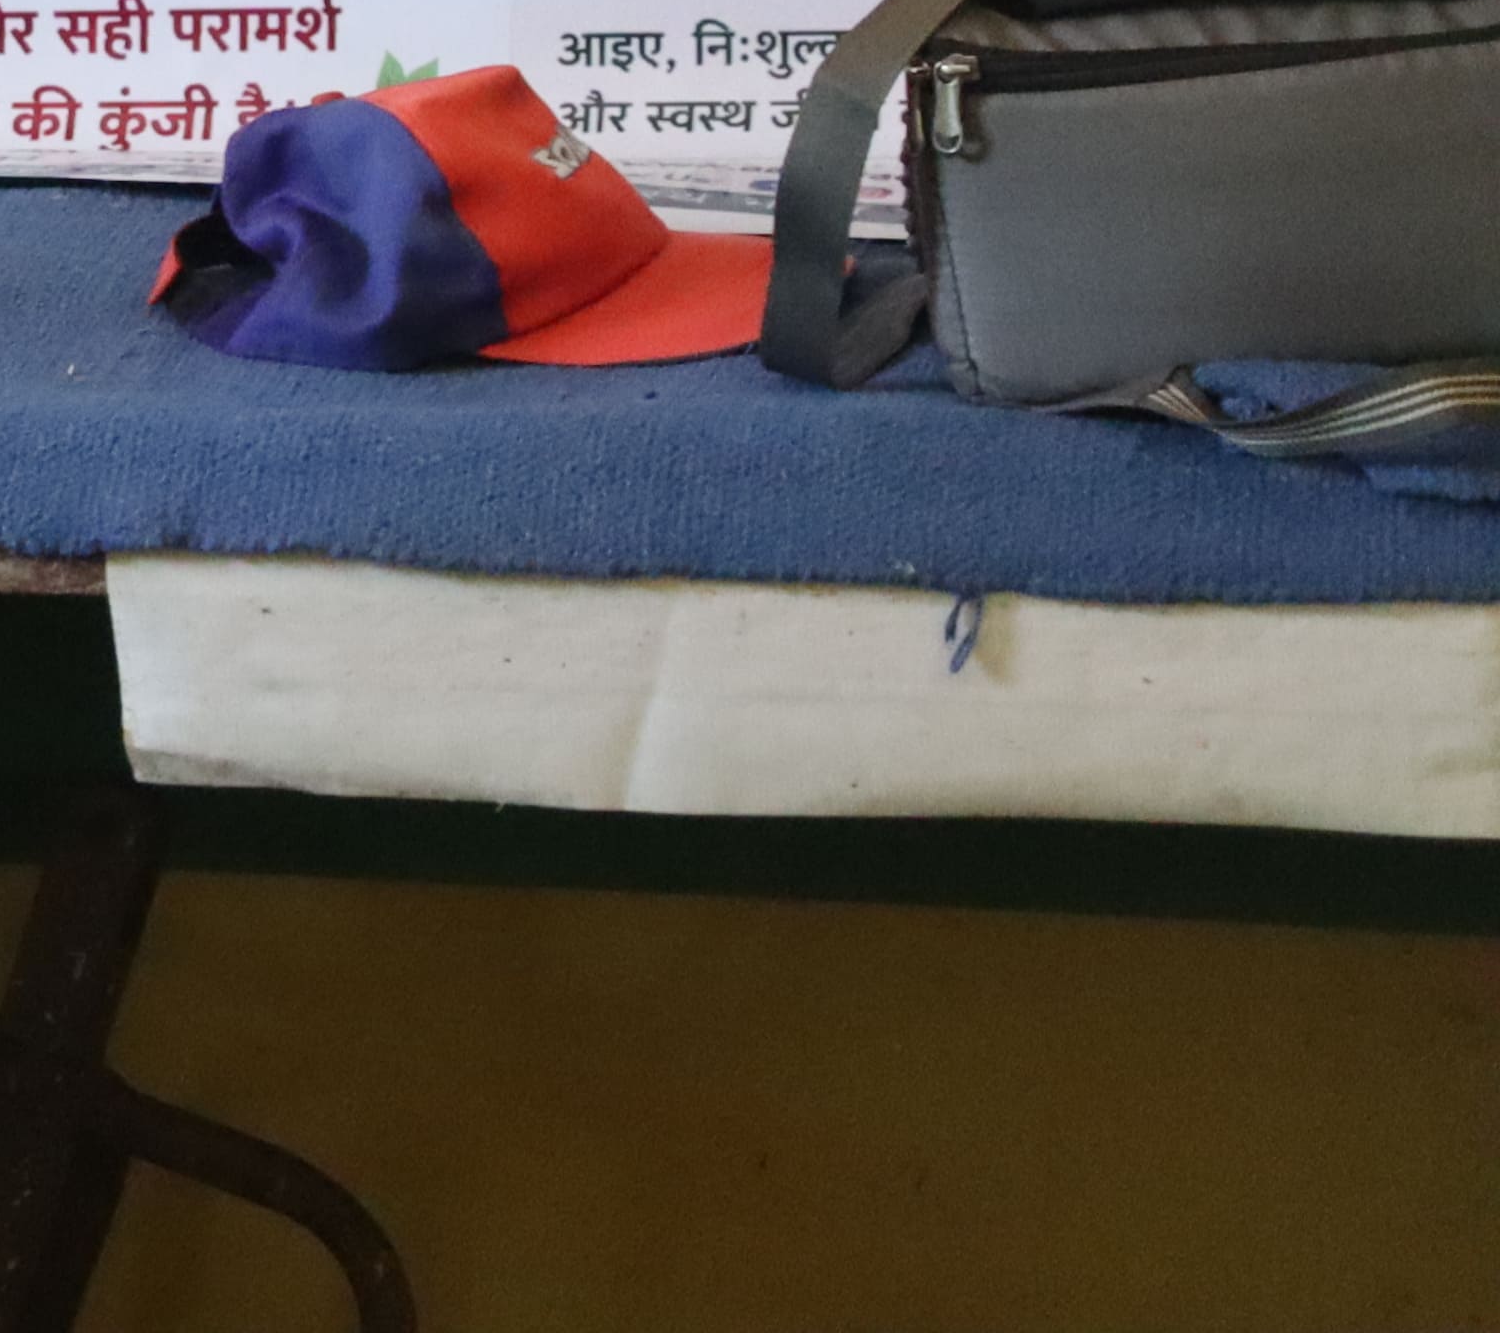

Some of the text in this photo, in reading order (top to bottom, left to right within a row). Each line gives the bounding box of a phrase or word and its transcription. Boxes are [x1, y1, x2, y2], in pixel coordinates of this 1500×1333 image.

[557, 31, 676, 74] आइए,
[12, 85, 82, 141] की
[100, 85, 217, 152] कुंजी
[561, 90, 631, 133] और
[646, 100, 756, 133] स्वस्थ
